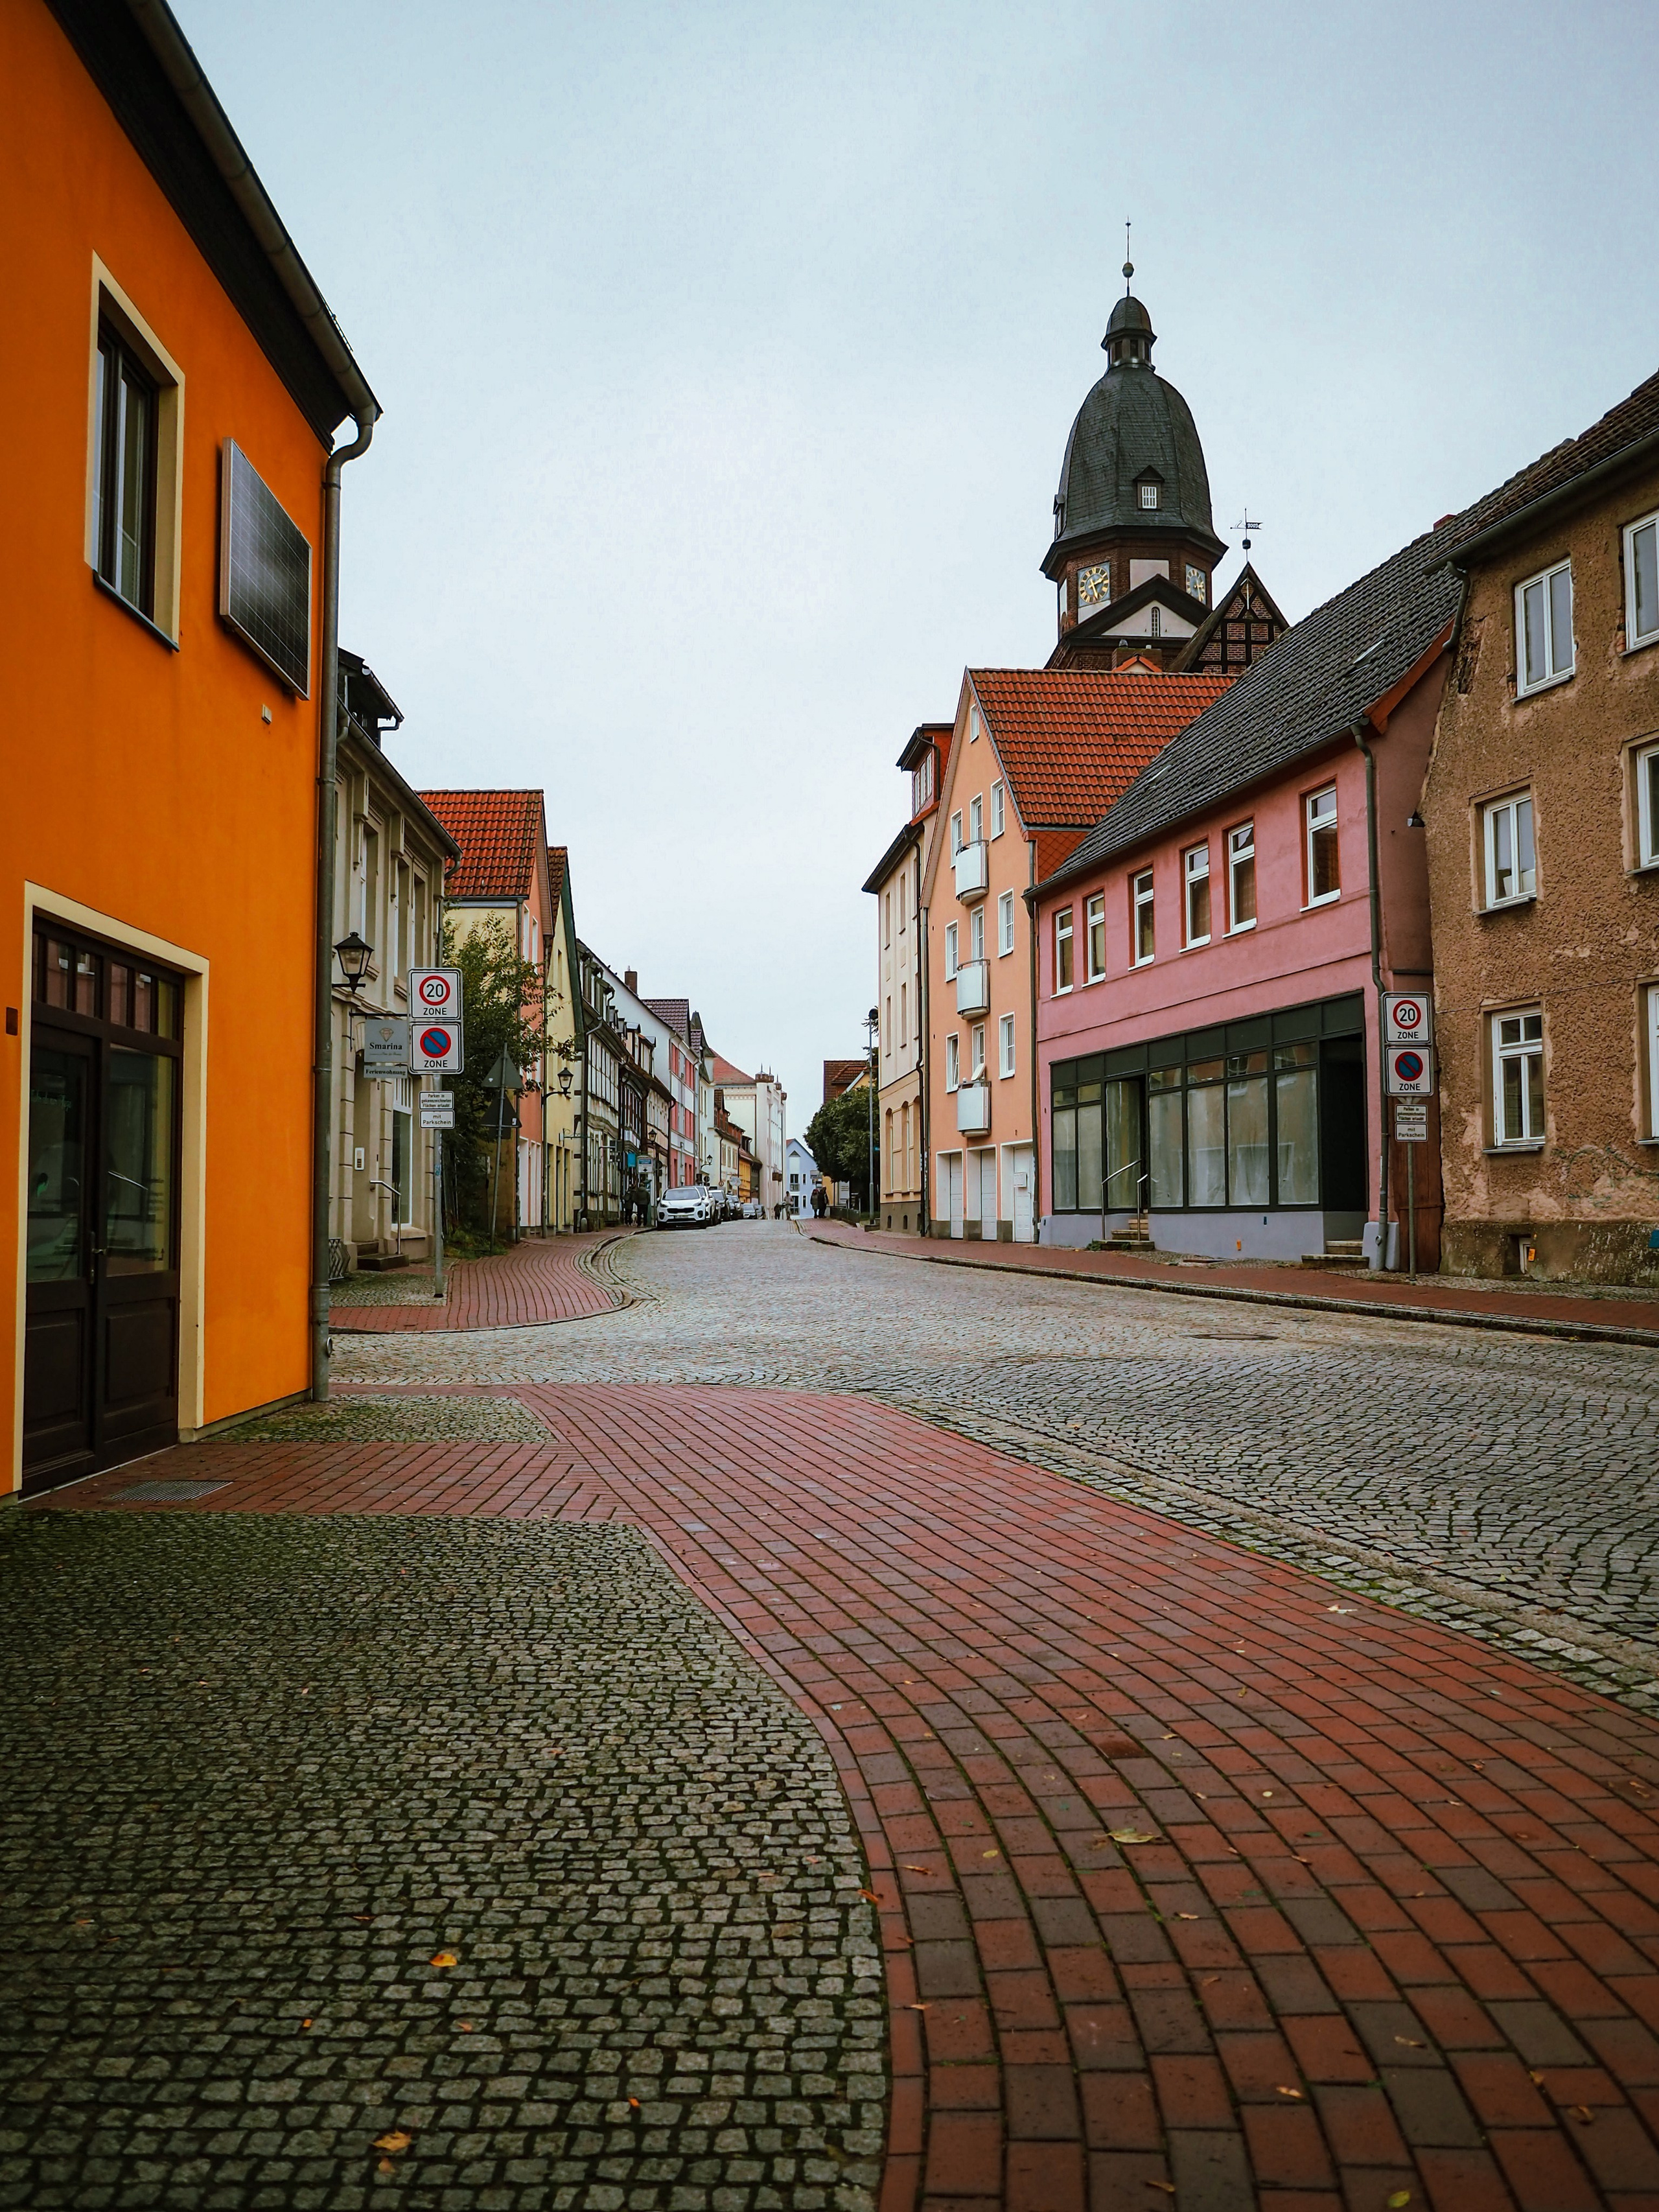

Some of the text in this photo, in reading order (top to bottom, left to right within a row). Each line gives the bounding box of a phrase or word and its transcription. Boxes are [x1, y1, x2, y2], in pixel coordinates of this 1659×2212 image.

[426, 984, 444, 997] 20
[1399, 1008, 1416, 1021] 20
[424, 1060, 448, 1068] ZONE
